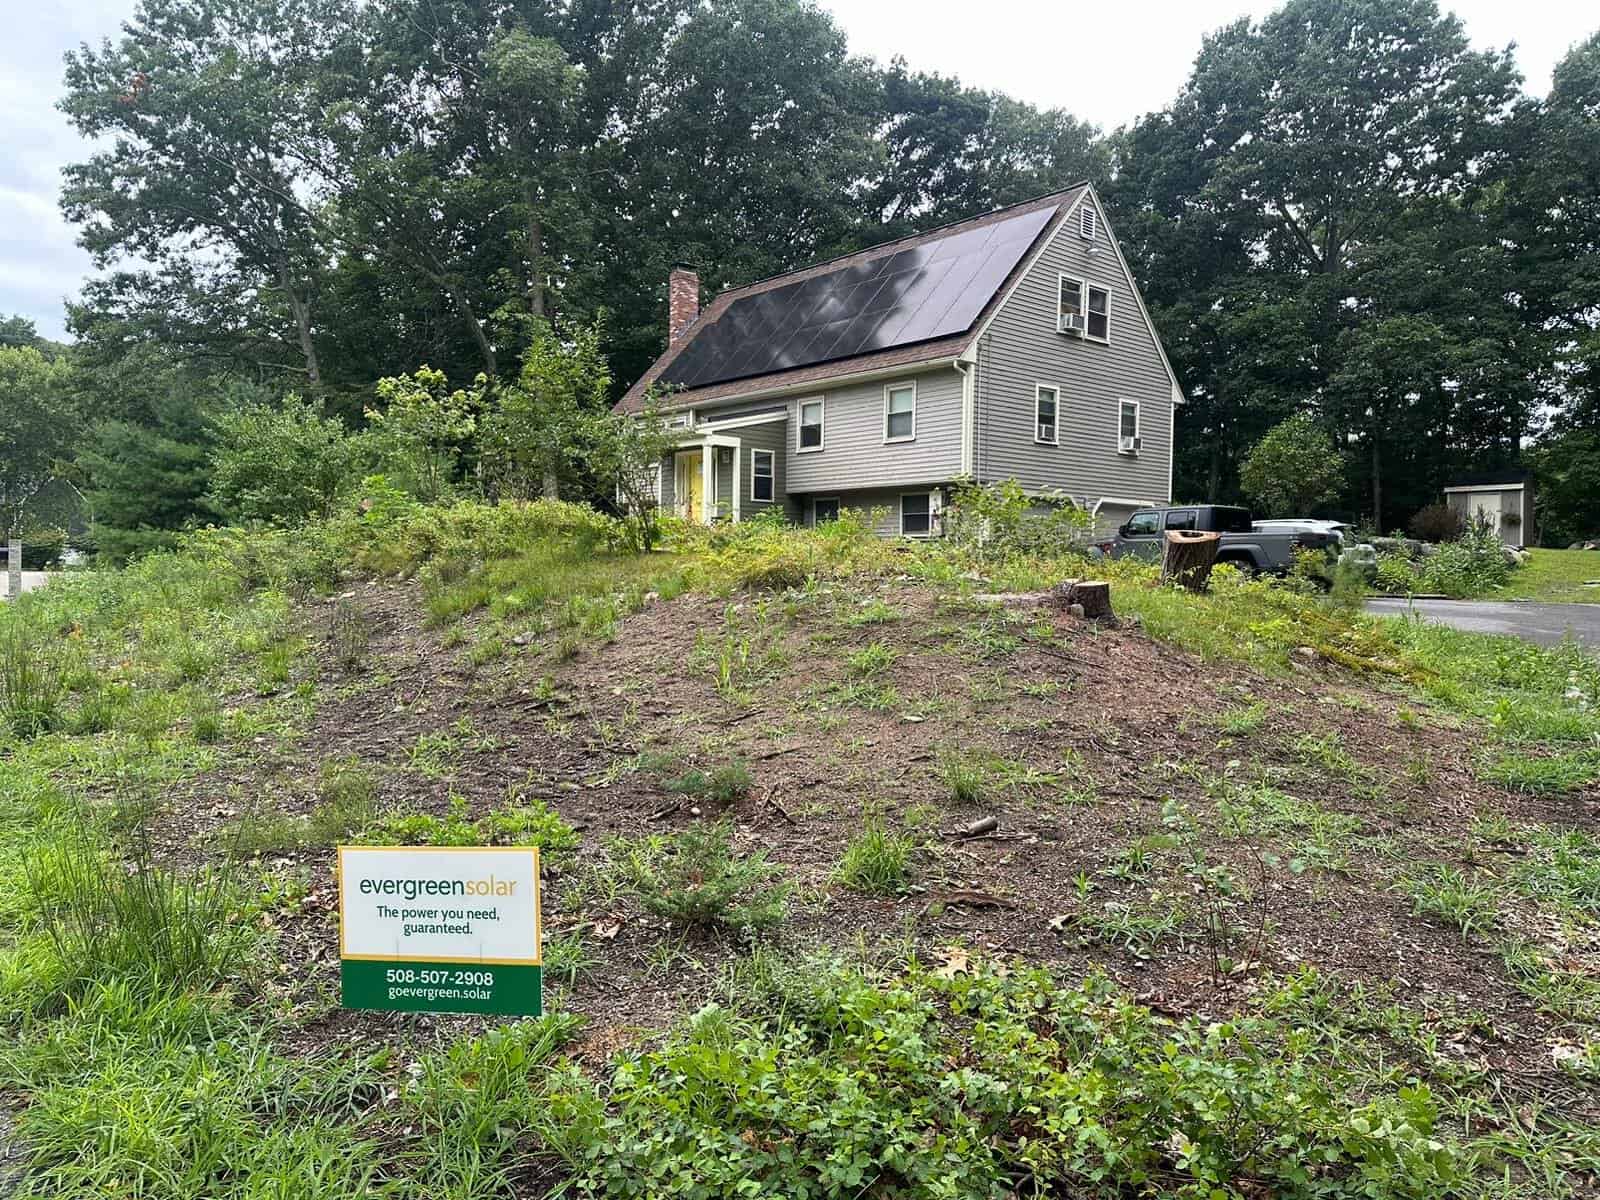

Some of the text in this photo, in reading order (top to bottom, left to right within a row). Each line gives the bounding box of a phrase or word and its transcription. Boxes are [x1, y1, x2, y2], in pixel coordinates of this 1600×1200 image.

[377, 905, 500, 922] The power you need,
[403, 922, 473, 936] guaranteed.
[386, 969, 494, 986] 508-507-2908
[388, 986, 492, 1001] goevergreen.solar
